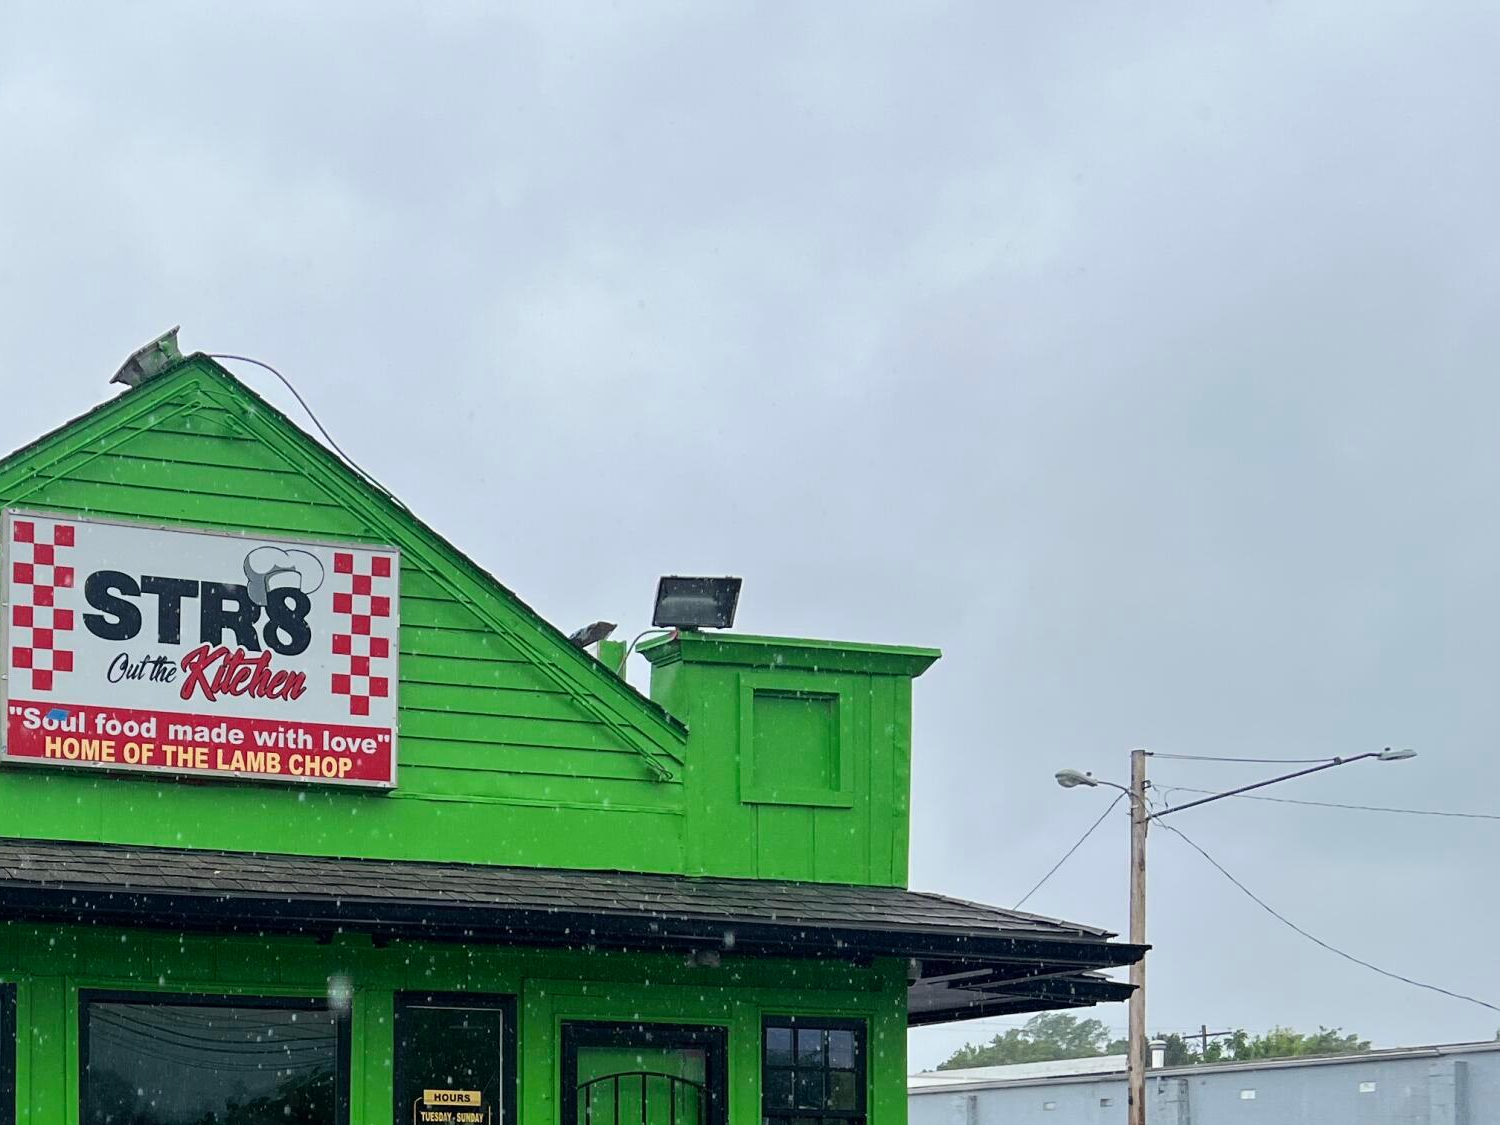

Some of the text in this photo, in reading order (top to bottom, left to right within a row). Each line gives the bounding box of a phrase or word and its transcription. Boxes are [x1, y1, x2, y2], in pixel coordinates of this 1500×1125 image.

[83, 569, 312, 656] STR8
[106, 644, 307, 702] Out the Kitchen
[95, 713, 157, 739] food
[168, 722, 245, 746] made
[253, 725, 313, 750] with
[322, 730, 391, 754] love"
[44, 736, 353, 778] HOME OF THE LAMB CHOP
[420, 1111, 453, 1122] TUESDAY
[456, 1112, 484, 1123] SUNDAY
[434, 1093, 471, 1103] HOURS
